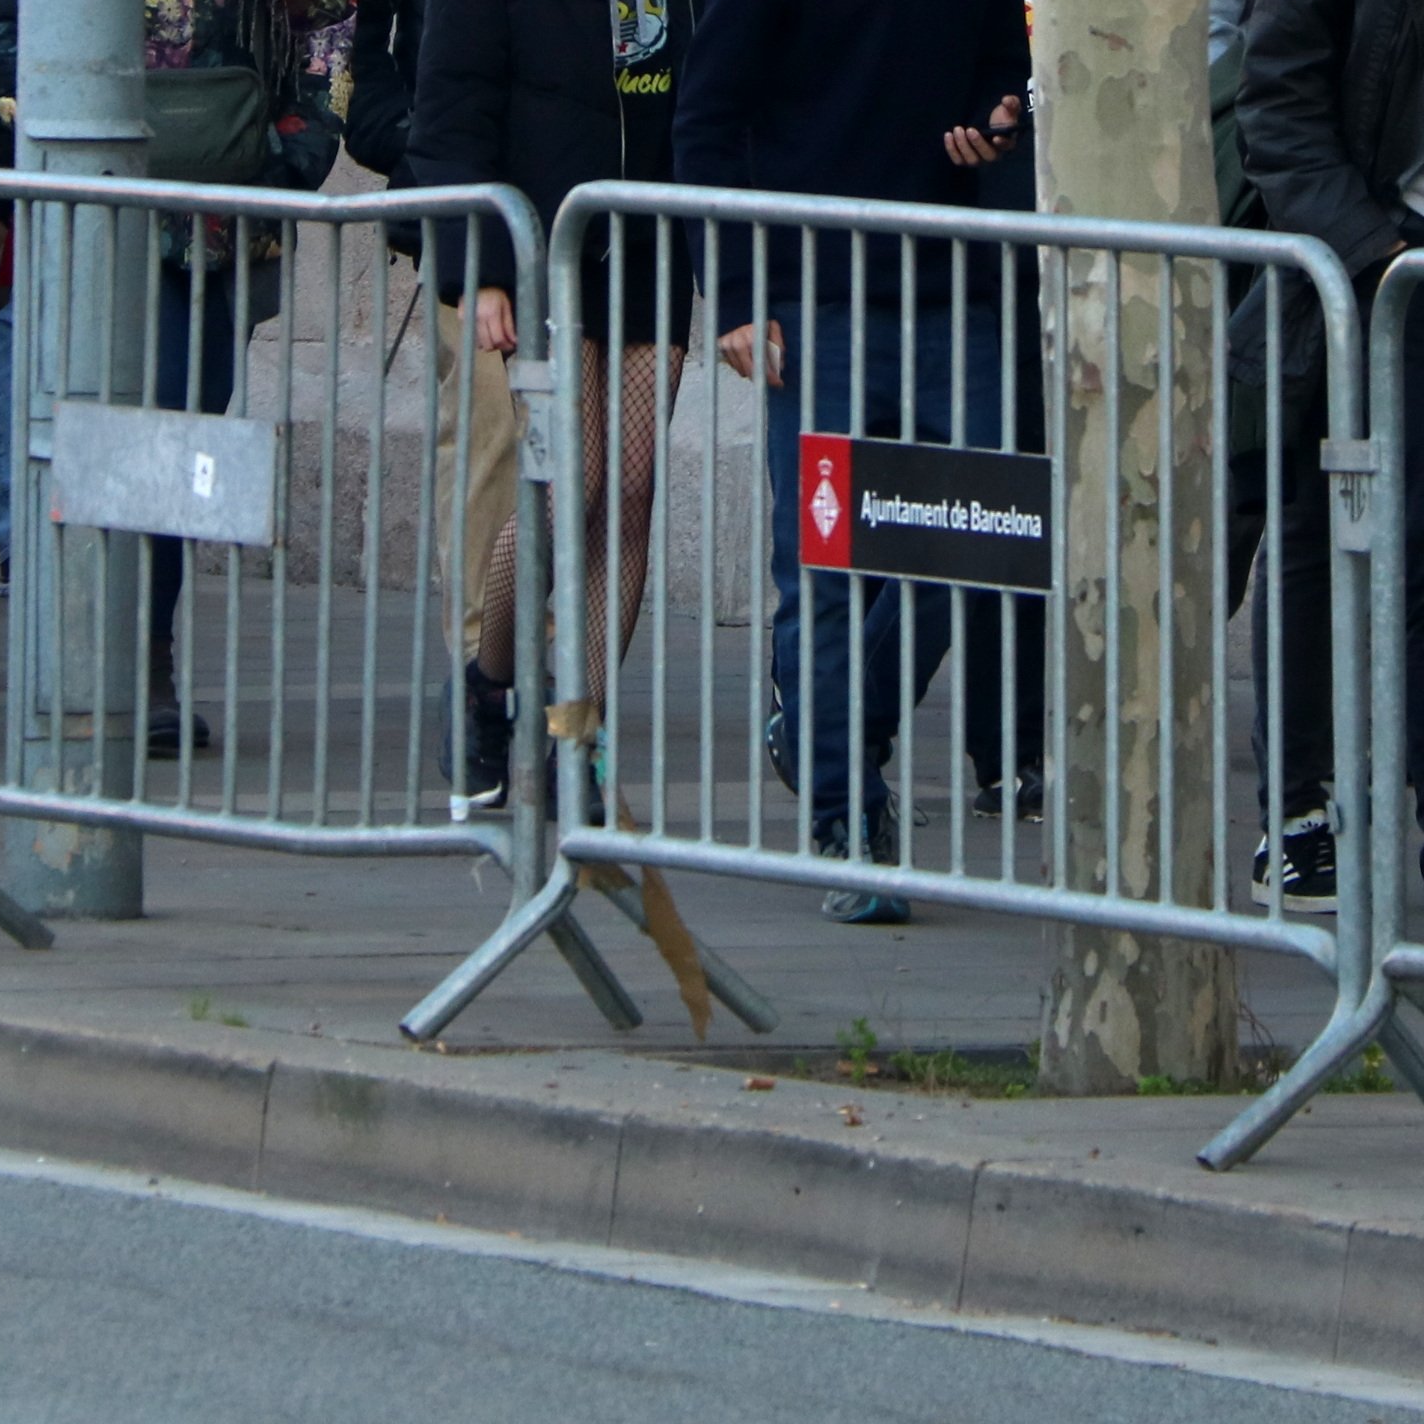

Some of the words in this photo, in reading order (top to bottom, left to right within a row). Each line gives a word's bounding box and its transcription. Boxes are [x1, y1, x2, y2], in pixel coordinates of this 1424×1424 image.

[616, 67, 672, 95] lució
[860, 490, 948, 528] Ajuntament
[950, 499, 968, 531] de
[970, 501, 1043, 538] Barcelona
